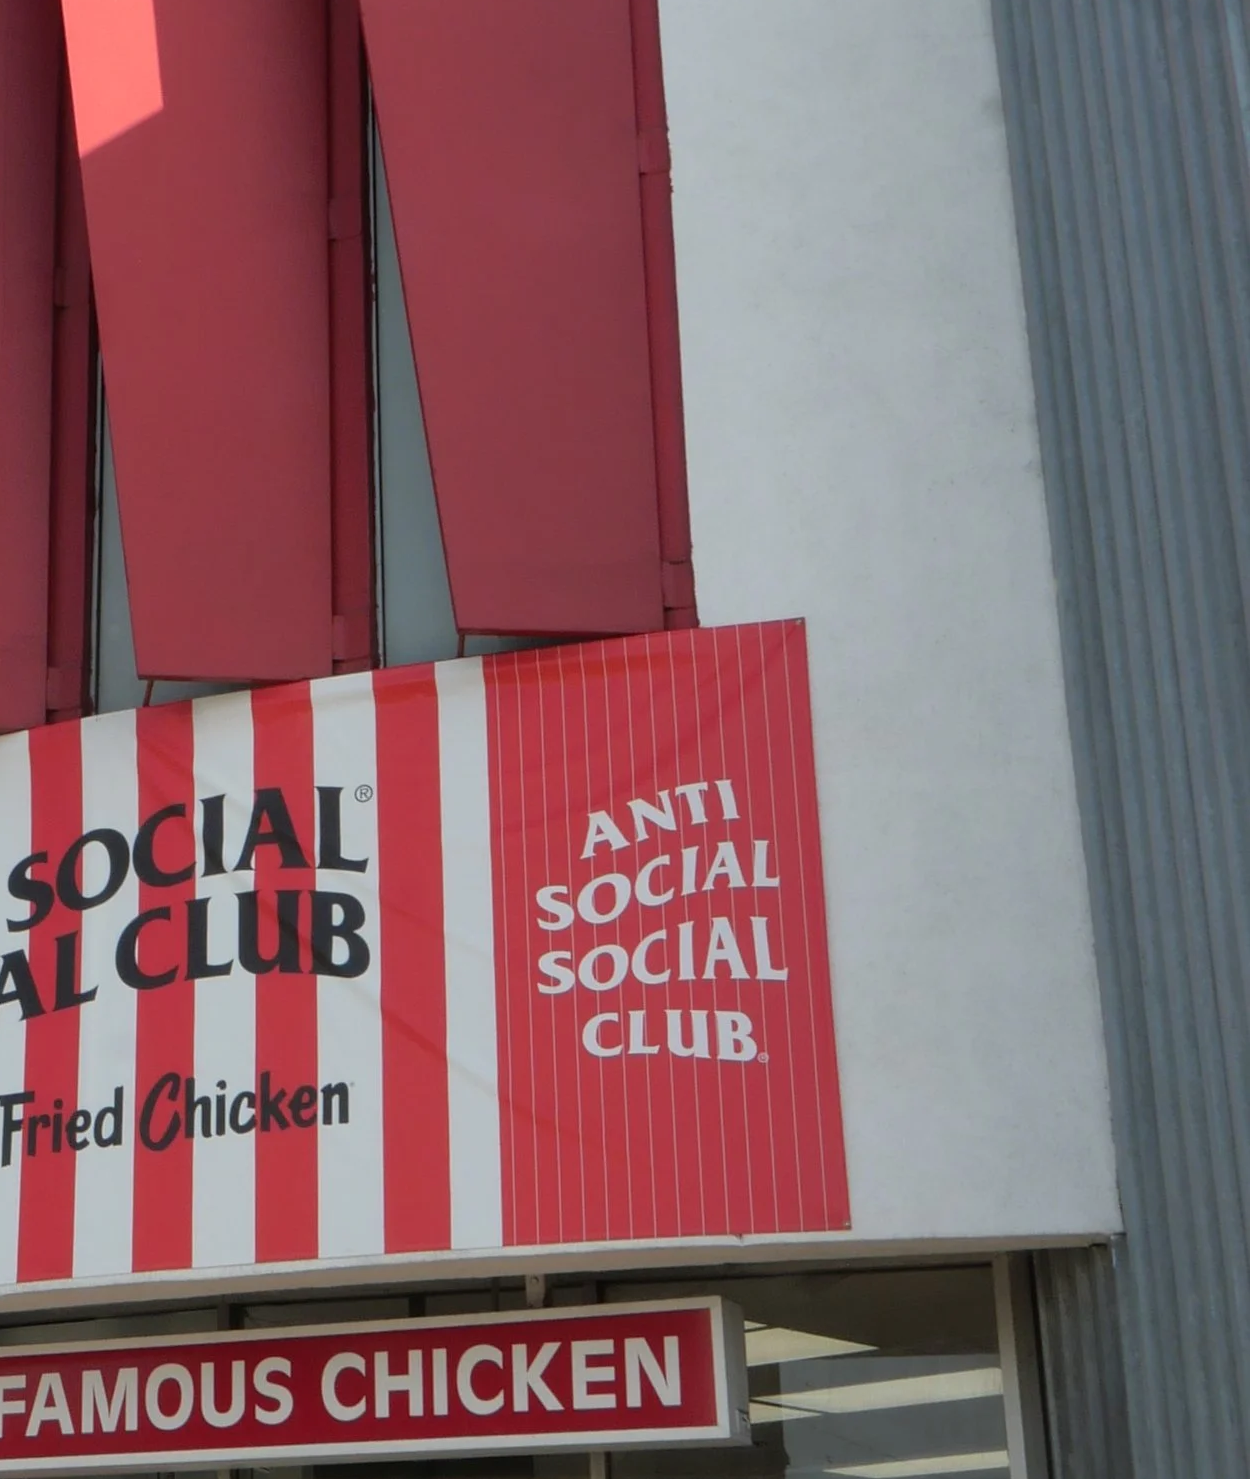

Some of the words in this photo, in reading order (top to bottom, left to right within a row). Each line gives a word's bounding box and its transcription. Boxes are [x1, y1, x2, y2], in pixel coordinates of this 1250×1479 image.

[579, 779, 740, 860] ANTI
[535, 839, 781, 932] SOCIAL
[114, 888, 371, 990] CLUB
[536, 916, 789, 995] SOCIAL
[138, 1070, 351, 1152] Chicken
[321, 1335, 681, 1423] CHICKEN
